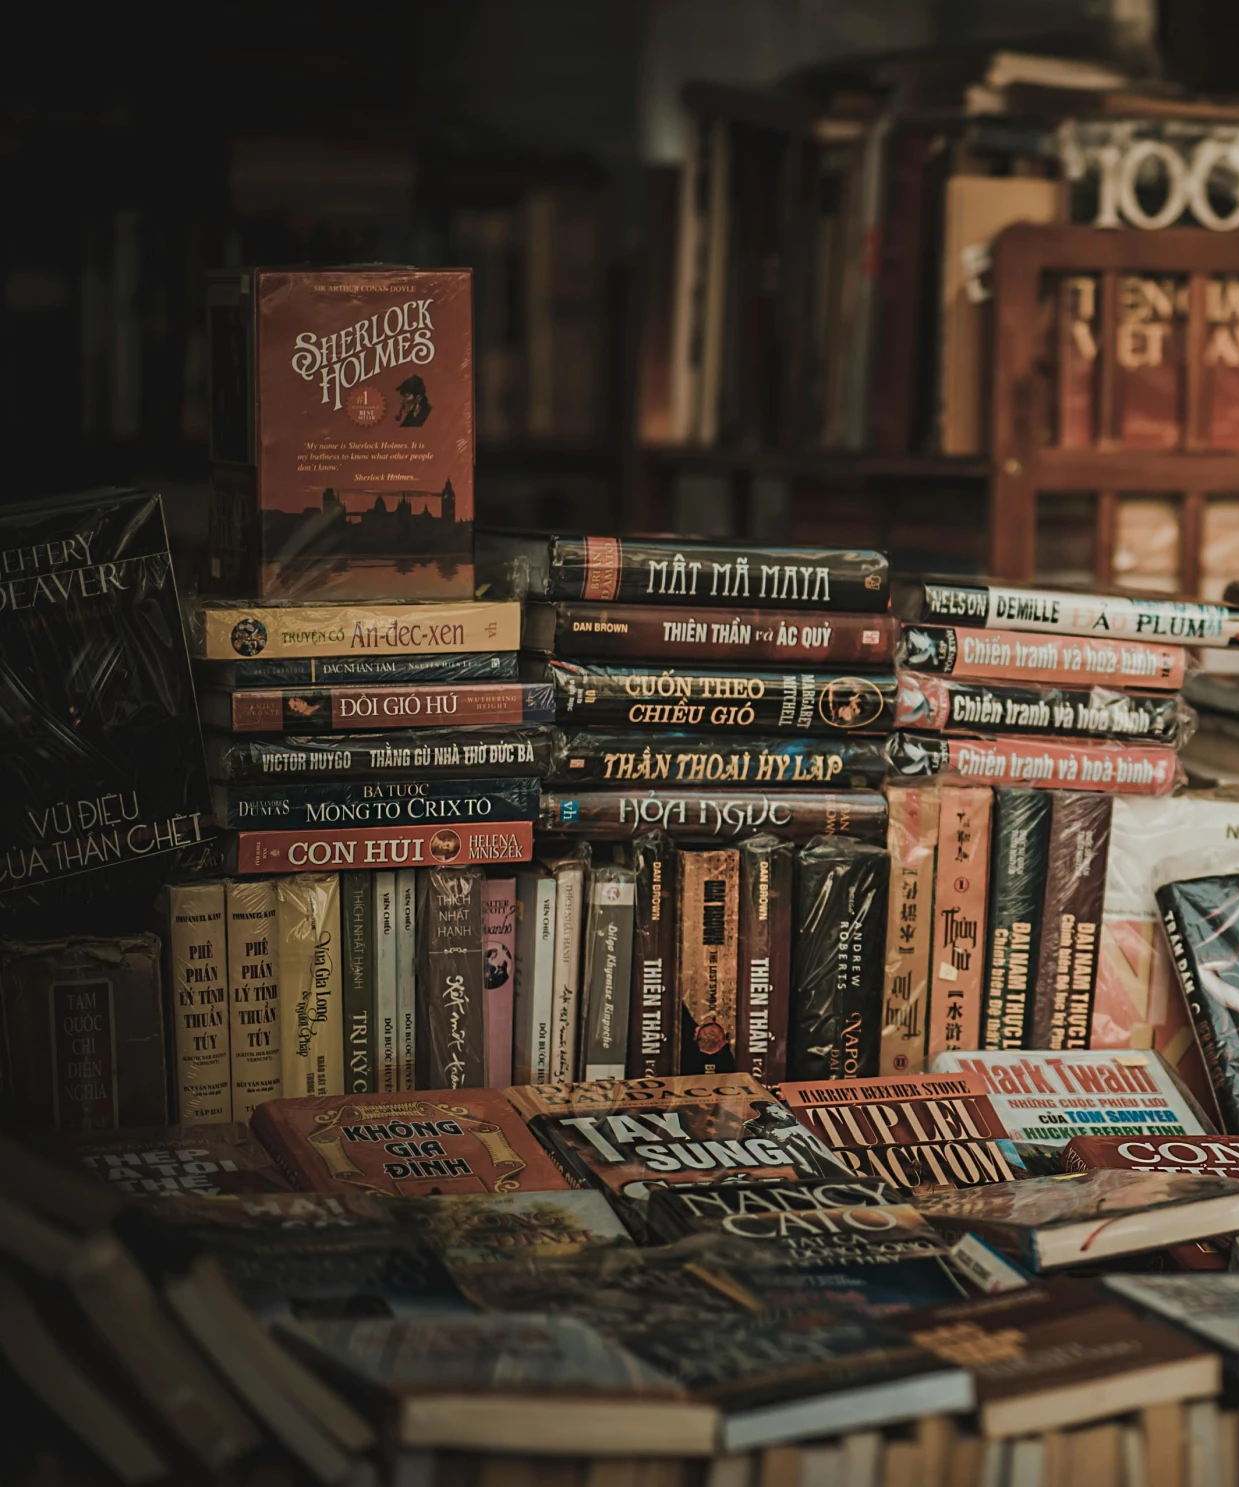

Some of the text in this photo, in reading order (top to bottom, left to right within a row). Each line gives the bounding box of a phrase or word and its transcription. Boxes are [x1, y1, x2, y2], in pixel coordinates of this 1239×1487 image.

[292, 299, 434, 380] SHERLOCK
[320, 329, 436, 412] HOLMES
[348, 442, 379, 450] Sherlock
[646, 553, 830, 601] MẬT MÃ MAYA
[930, 589, 1206, 638] NELSON DEMILLE PLUM
[573, 622, 592, 632] DAN
[594, 623, 628, 633] BROWN
[663, 618, 707, 643] THIÊN
[711, 617, 751, 644] THẦN
[776, 621, 797, 646] ÁC
[963, 635, 1081, 671] Chiến tranh và
[625, 669, 765, 699] CUỐN THEO
[340, 692, 458, 717] ĐỒI GIÓ HÚ
[628, 696, 755, 725] CHIỀU GIÓ
[778, 675, 796, 727] MITCHELL
[796, 674, 816, 729] MARGARET
[953, 694, 1004, 724] Chiến
[1006, 701, 1050, 727] tranh
[262, 753, 306, 772] VICTOR
[310, 751, 351, 770] HUYGO
[370, 742, 410, 768] THẰNG
[434, 743, 460, 766] NHÀ
[958, 747, 1006, 776] Chiến
[1010, 755, 1055, 778] tranh
[1058, 753, 1078, 779] và
[288, 840, 356, 865] CON
[469, 833, 518, 848] HELENA
[469, 846, 524, 860] MNISZEK
[189, 940, 213, 960] PHÊ
[245, 937, 268, 956] PHÊ
[642, 861, 667, 1054] DAN BROWN THIÊN THẦN
[749, 861, 776, 1053] DAN BROWN THIÊN THẦN
[837, 921, 849, 989] ROBERTS
[851, 922, 862, 987] ANDREW
[186, 961, 218, 983] PHÁN
[242, 958, 272, 979] PHÁN
[709, 951, 718, 986] THE LOST
[1007, 952, 1029, 990] NAM
[1072, 952, 1093, 990] NAM
[234, 982, 278, 1002] LÝ TÍNH
[602, 924, 619, 1049] Dilgo Khyentse Rinpoche
[239, 1001, 276, 1025] THUẦN
[350, 1011, 367, 1044] TRI
[193, 1032, 217, 1051] TÚY
[248, 1029, 271, 1048] TÚY
[798, 1080, 971, 1103] HARRIET BEECHER STOWE
[956, 1058, 1163, 1095] Mark Twain
[340, 1119, 464, 1142] KHÔNG
[1065, 1111, 1106, 1124] TOM
[1108, 1111, 1178, 1123] SAWYER
[384, 1140, 447, 1158] GIA
[560, 1112, 690, 1162] TAY
[383, 1158, 473, 1179] ĐÌNH
[680, 1182, 896, 1216] NANCY
[722, 1207, 897, 1238] CATO
